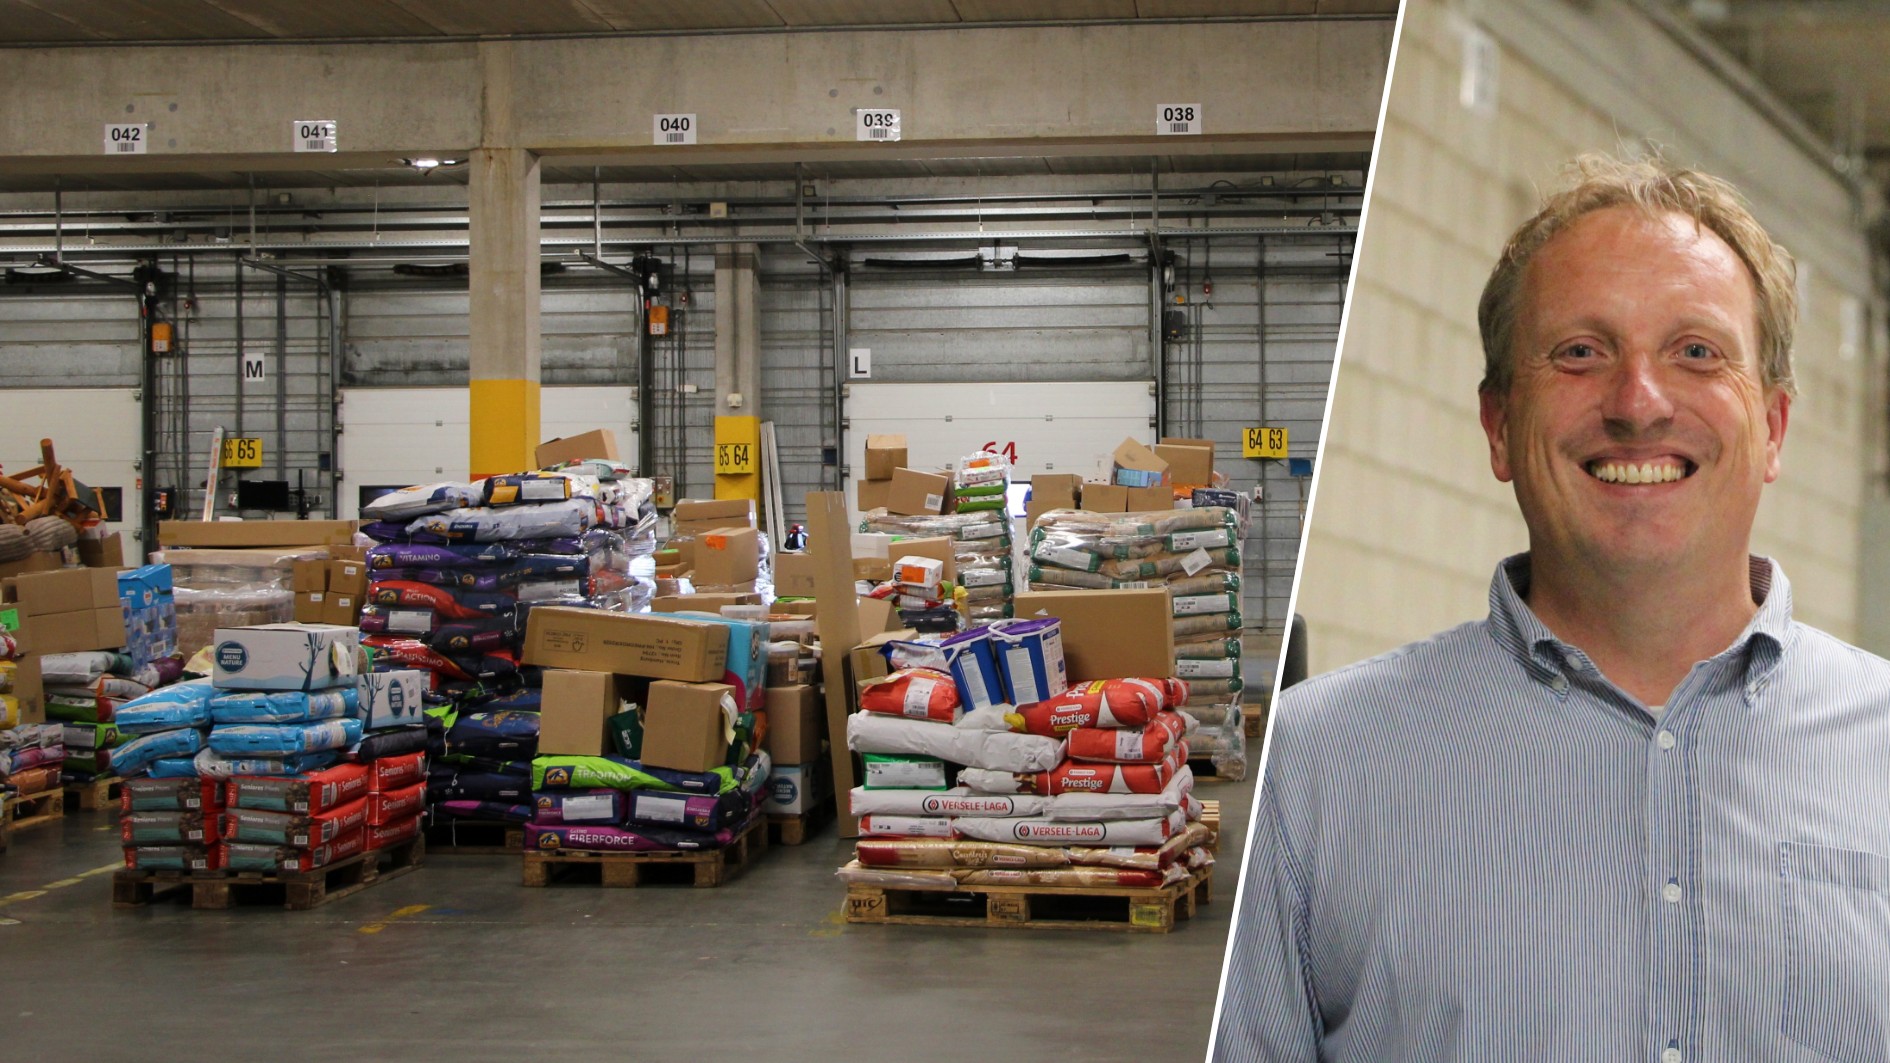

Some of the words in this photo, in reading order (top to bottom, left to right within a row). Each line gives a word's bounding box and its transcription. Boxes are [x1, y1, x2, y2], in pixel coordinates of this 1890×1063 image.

[863, 113, 894, 128] 039
[1164, 106, 1195, 121] 038
[660, 117, 690, 131] 040
[111, 127, 141, 142] 042
[301, 125, 329, 139] 041
[246, 360, 263, 378] M
[854, 356, 867, 374] L
[1248, 429, 1263, 450] 64
[1269, 429, 1283, 450] 63
[237, 440, 256, 460] 65
[719, 445, 730, 466] 65
[734, 444, 749, 466] 64
[400, 553, 441, 563] VITAMINO
[404, 592, 437, 604] ACTION
[219, 659, 244, 667] NATURE
[1050, 711, 1091, 725] Prestige
[576, 768, 633, 783] TRADITION
[1060, 777, 1103, 790] Prestige
[942, 800, 1008, 811] VERSELE-LAGA
[1033, 826, 1100, 836] VERSELE-LAGA
[569, 834, 635, 845] FIBERFORCE
